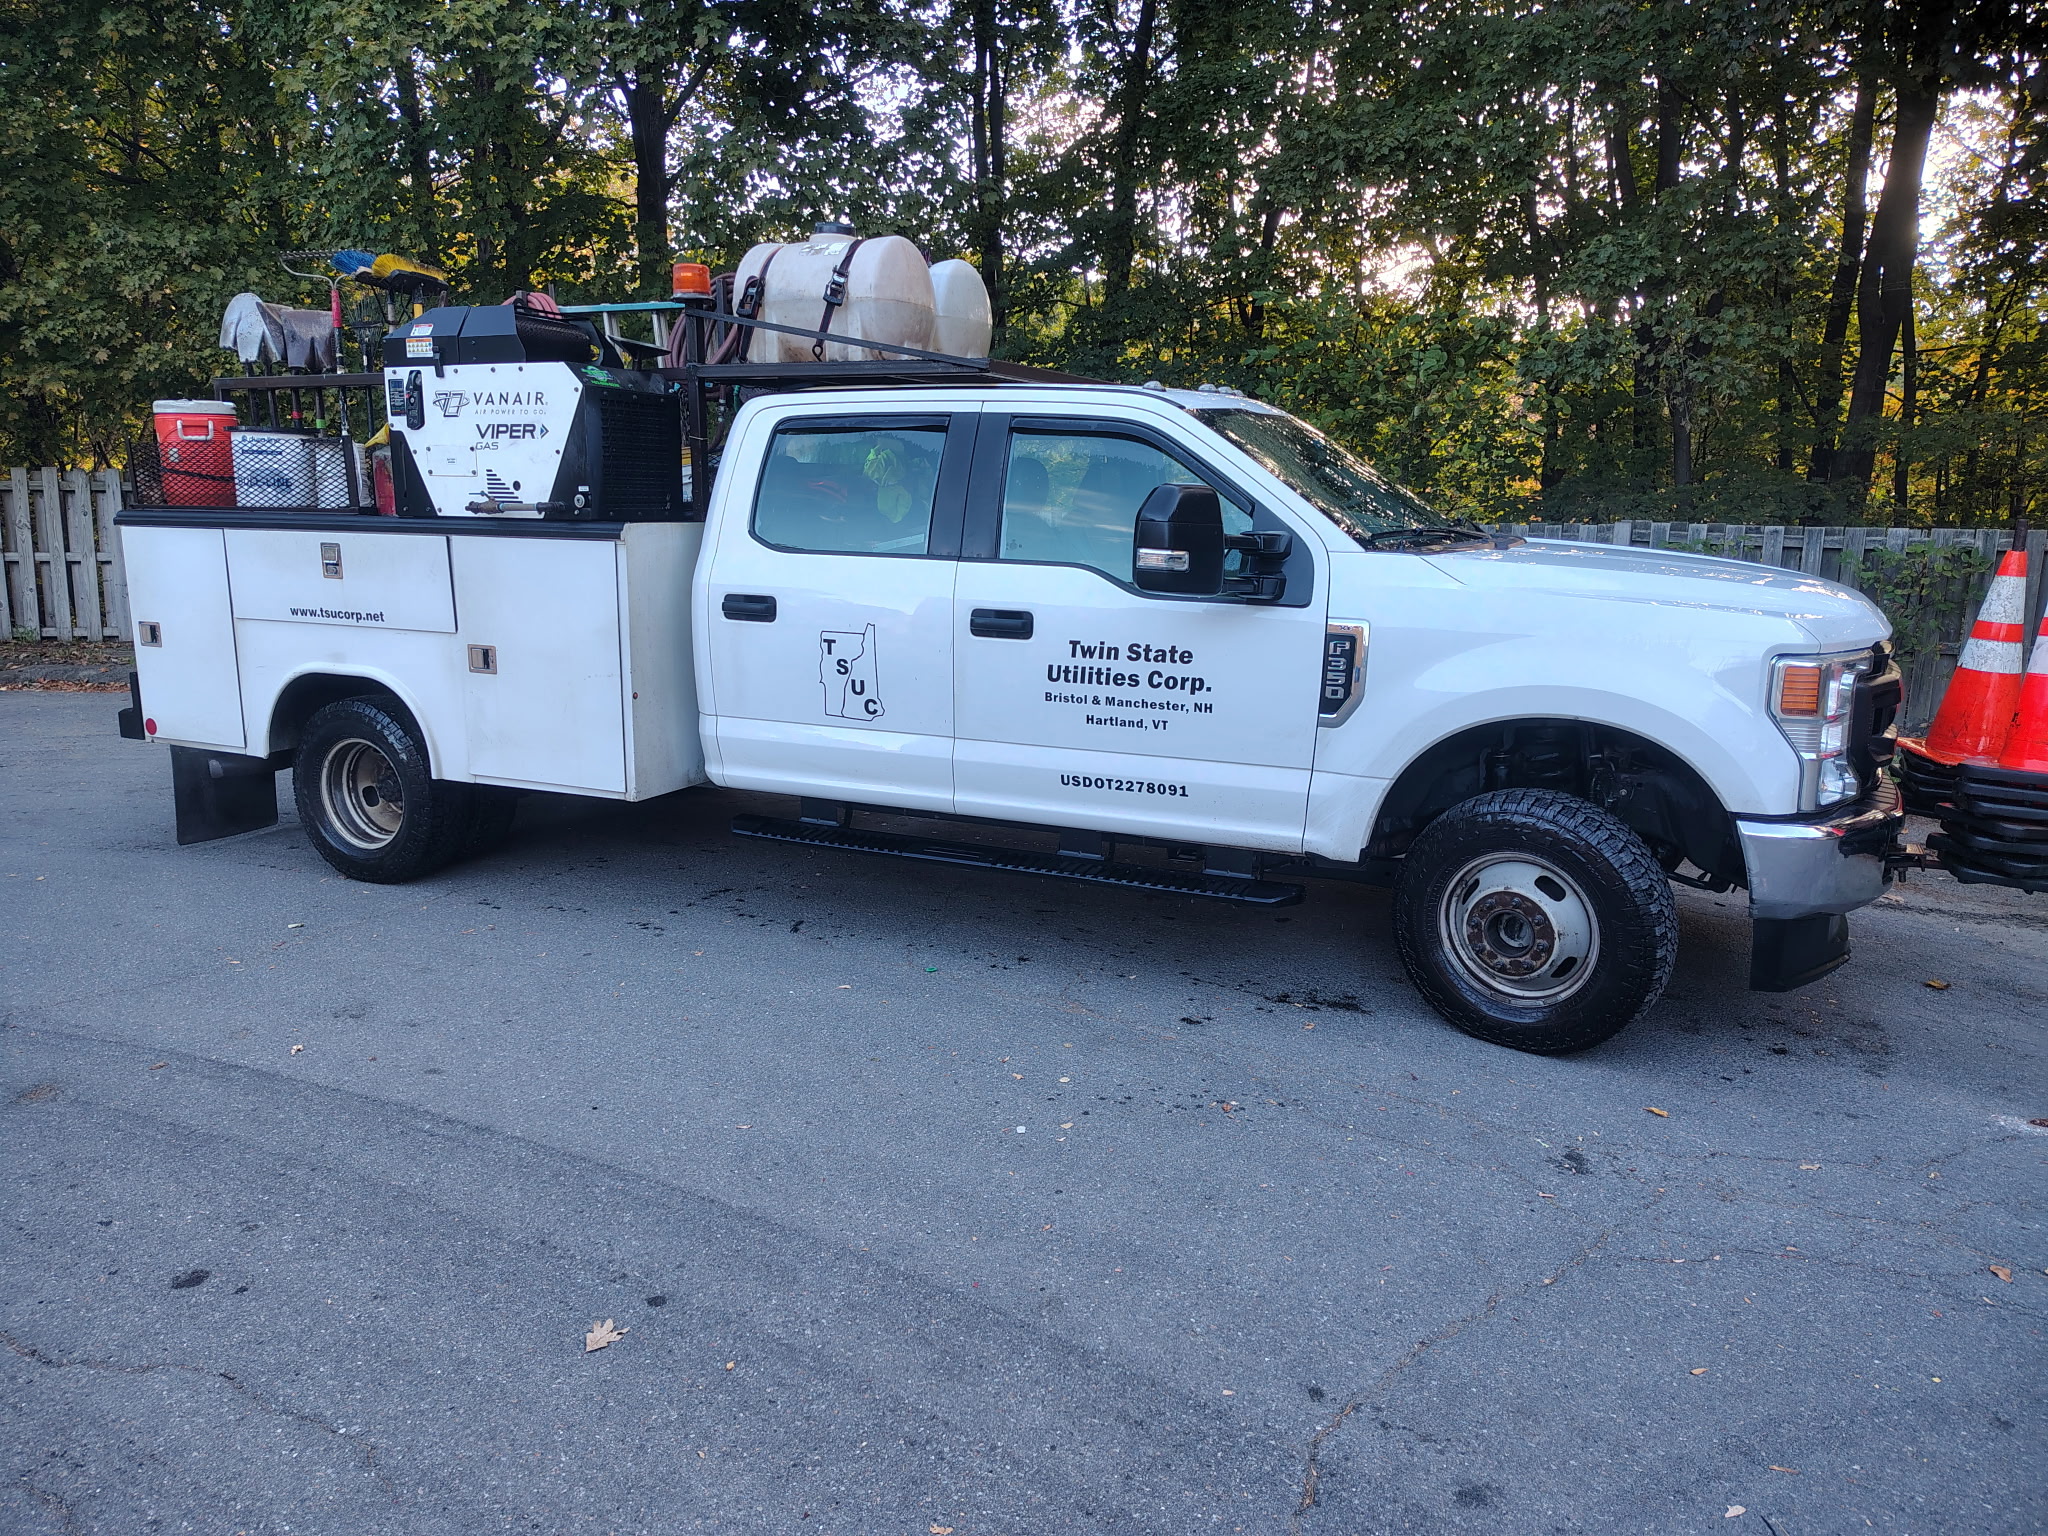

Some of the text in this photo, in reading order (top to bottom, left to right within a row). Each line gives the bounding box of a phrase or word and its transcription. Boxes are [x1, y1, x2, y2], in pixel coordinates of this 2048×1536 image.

[473, 391, 545, 406] VANAIR
[475, 423, 537, 440] VIPER
[475, 441, 499, 451] GAS
[289, 607, 385, 623] www.tsucorp.net
[1068, 640, 1194, 665] Twin State
[823, 638, 879, 716] T S U C
[1047, 664, 1213, 696] Utilities Corp.
[1044, 691, 1213, 714] Bristol & Manchester, NH
[1085, 714, 1169, 731] Hartland, VT
[1060, 773, 1189, 798] USDOT2278091
